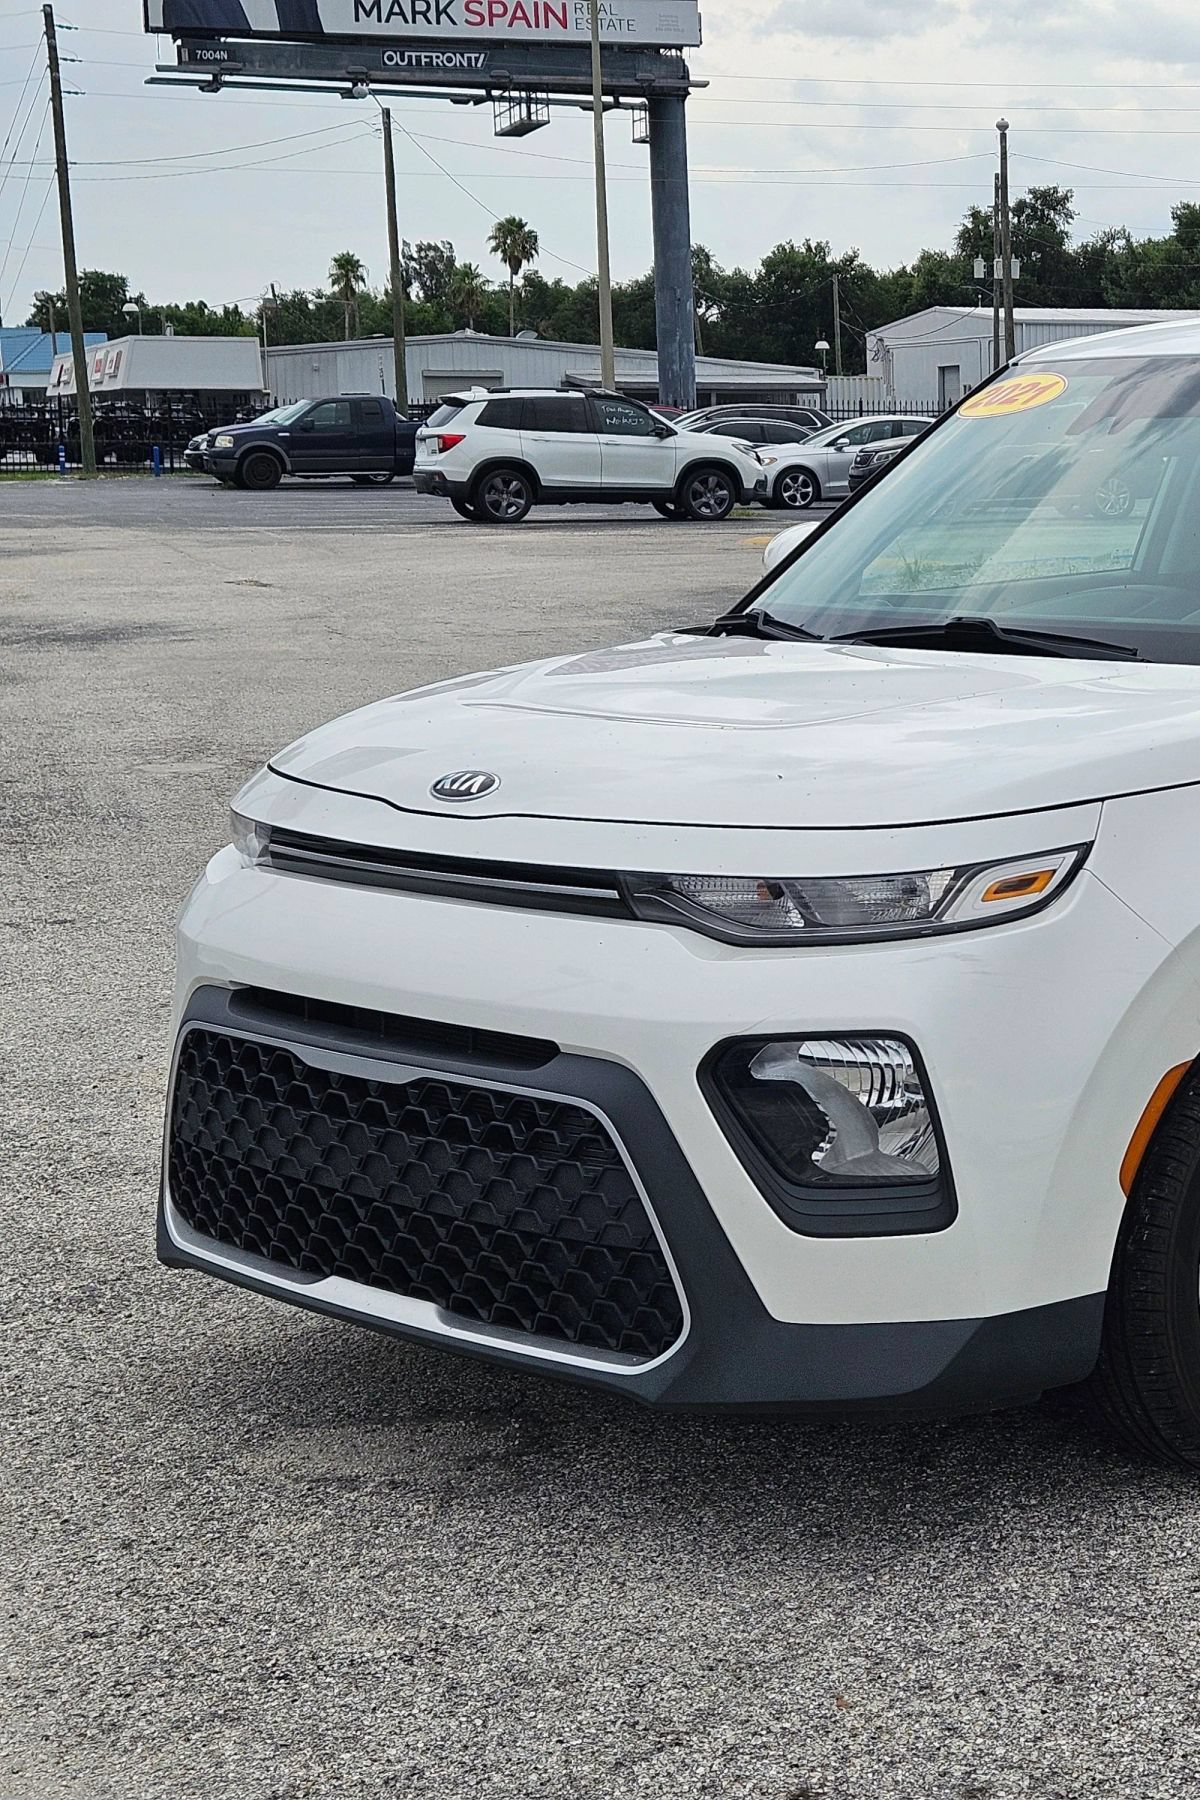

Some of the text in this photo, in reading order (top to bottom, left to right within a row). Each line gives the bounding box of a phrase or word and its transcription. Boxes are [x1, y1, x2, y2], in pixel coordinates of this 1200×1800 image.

[353, 0, 568, 30] MARK SPAIN
[575, 17, 637, 32] ESTATE
[195, 49, 228, 60] 7004N
[962, 379, 1062, 412] 2021
[434, 771, 488, 795] KIA
